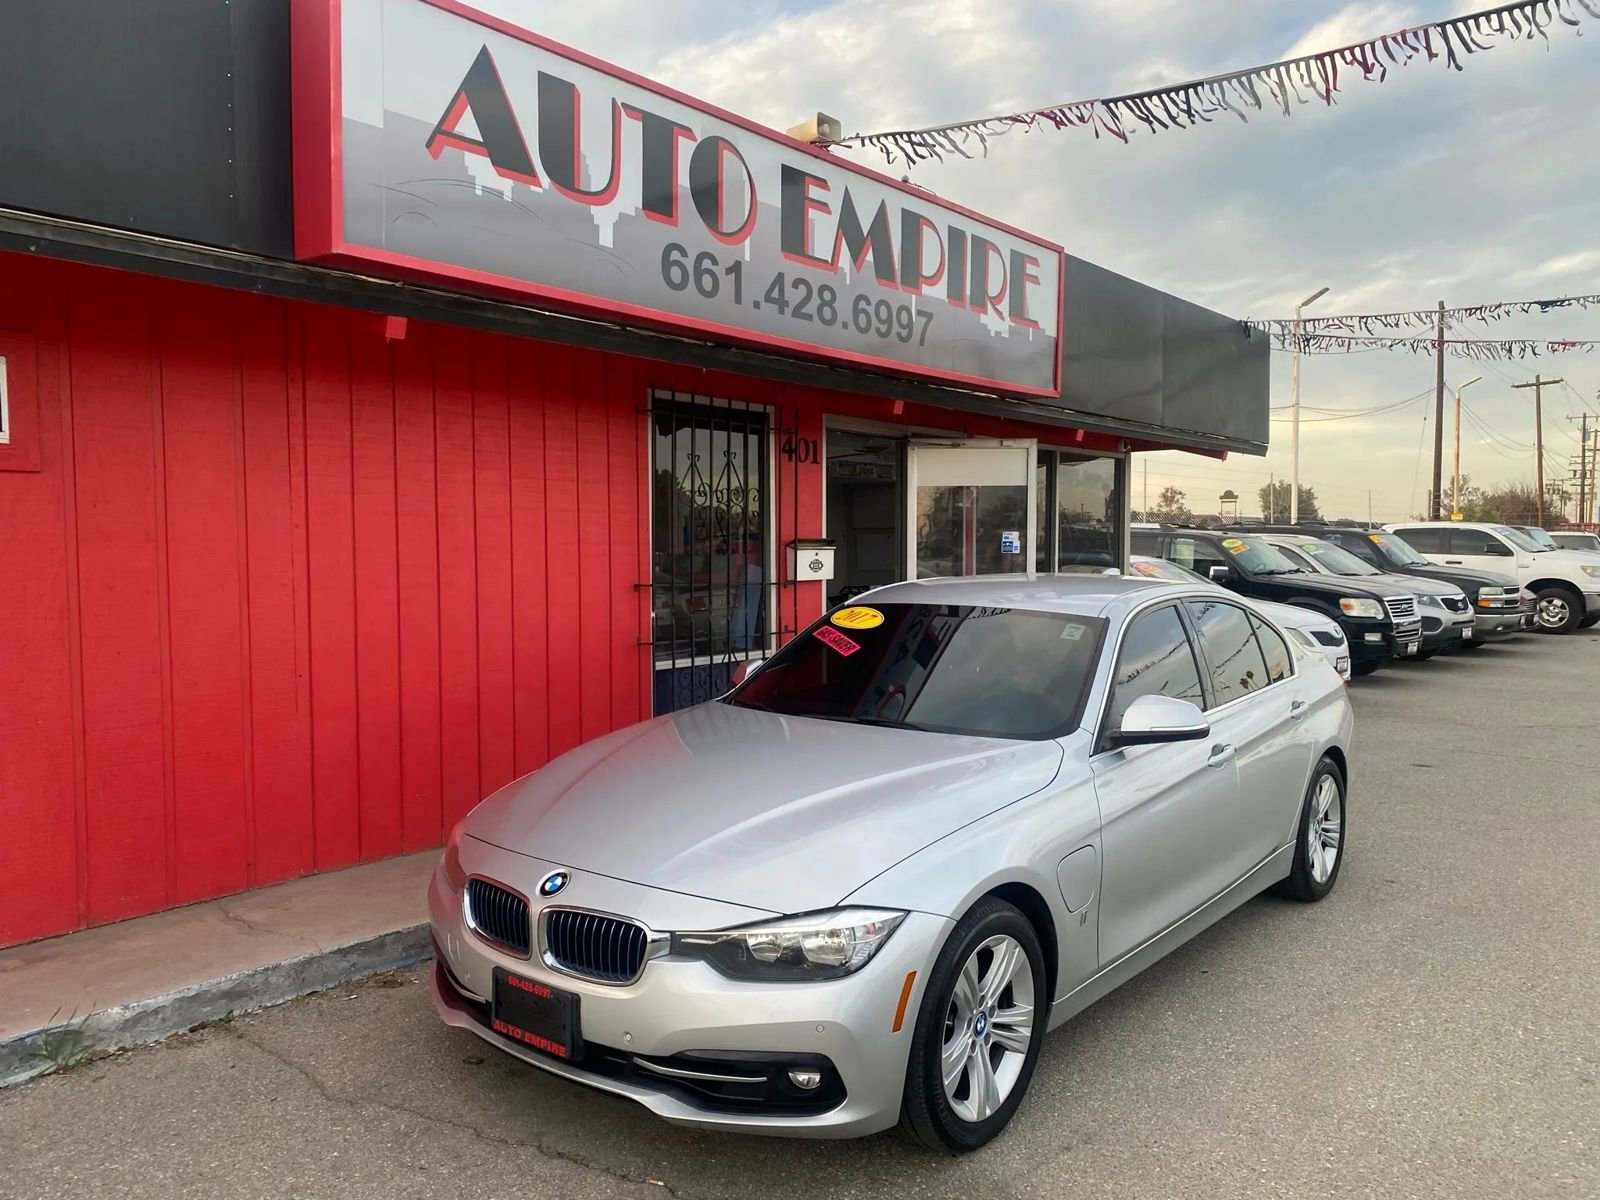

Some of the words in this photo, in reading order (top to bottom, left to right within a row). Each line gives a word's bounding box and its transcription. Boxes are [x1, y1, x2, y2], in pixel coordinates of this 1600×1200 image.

[425, 43, 757, 245] AUTO
[780, 163, 1042, 329] EMPIRE
[661, 242, 934, 347] 661.428.6997
[781, 435, 820, 464] 401
[494, 1019, 521, 1037] AUTO
[525, 1032, 566, 1056] EMPIRE
